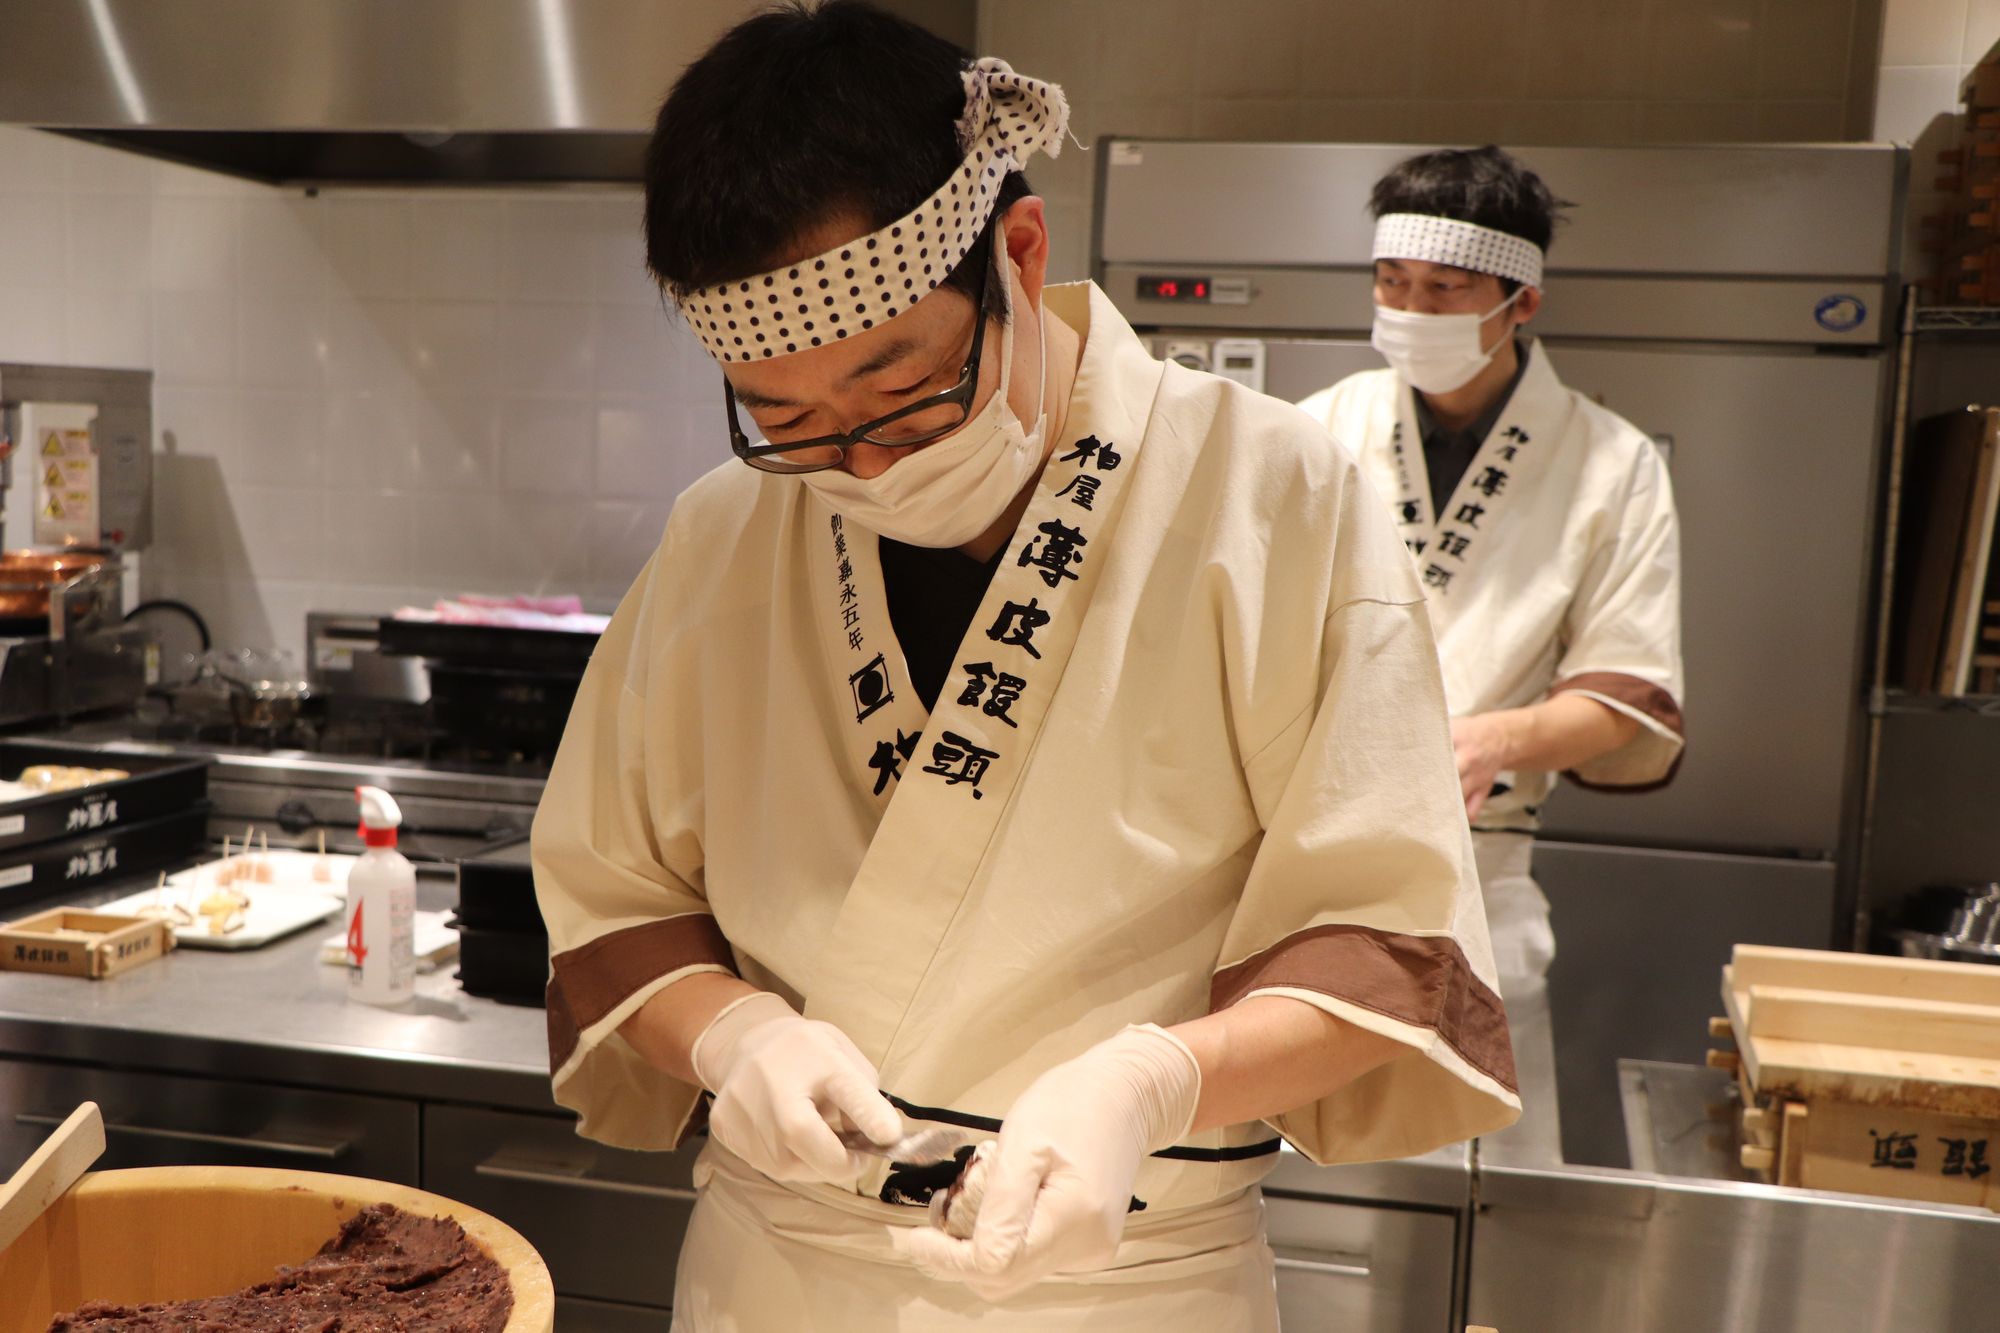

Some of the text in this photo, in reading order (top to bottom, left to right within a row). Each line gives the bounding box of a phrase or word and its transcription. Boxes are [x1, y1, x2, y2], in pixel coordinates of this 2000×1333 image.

[830, 513, 864, 652] 創業嘉永五年
